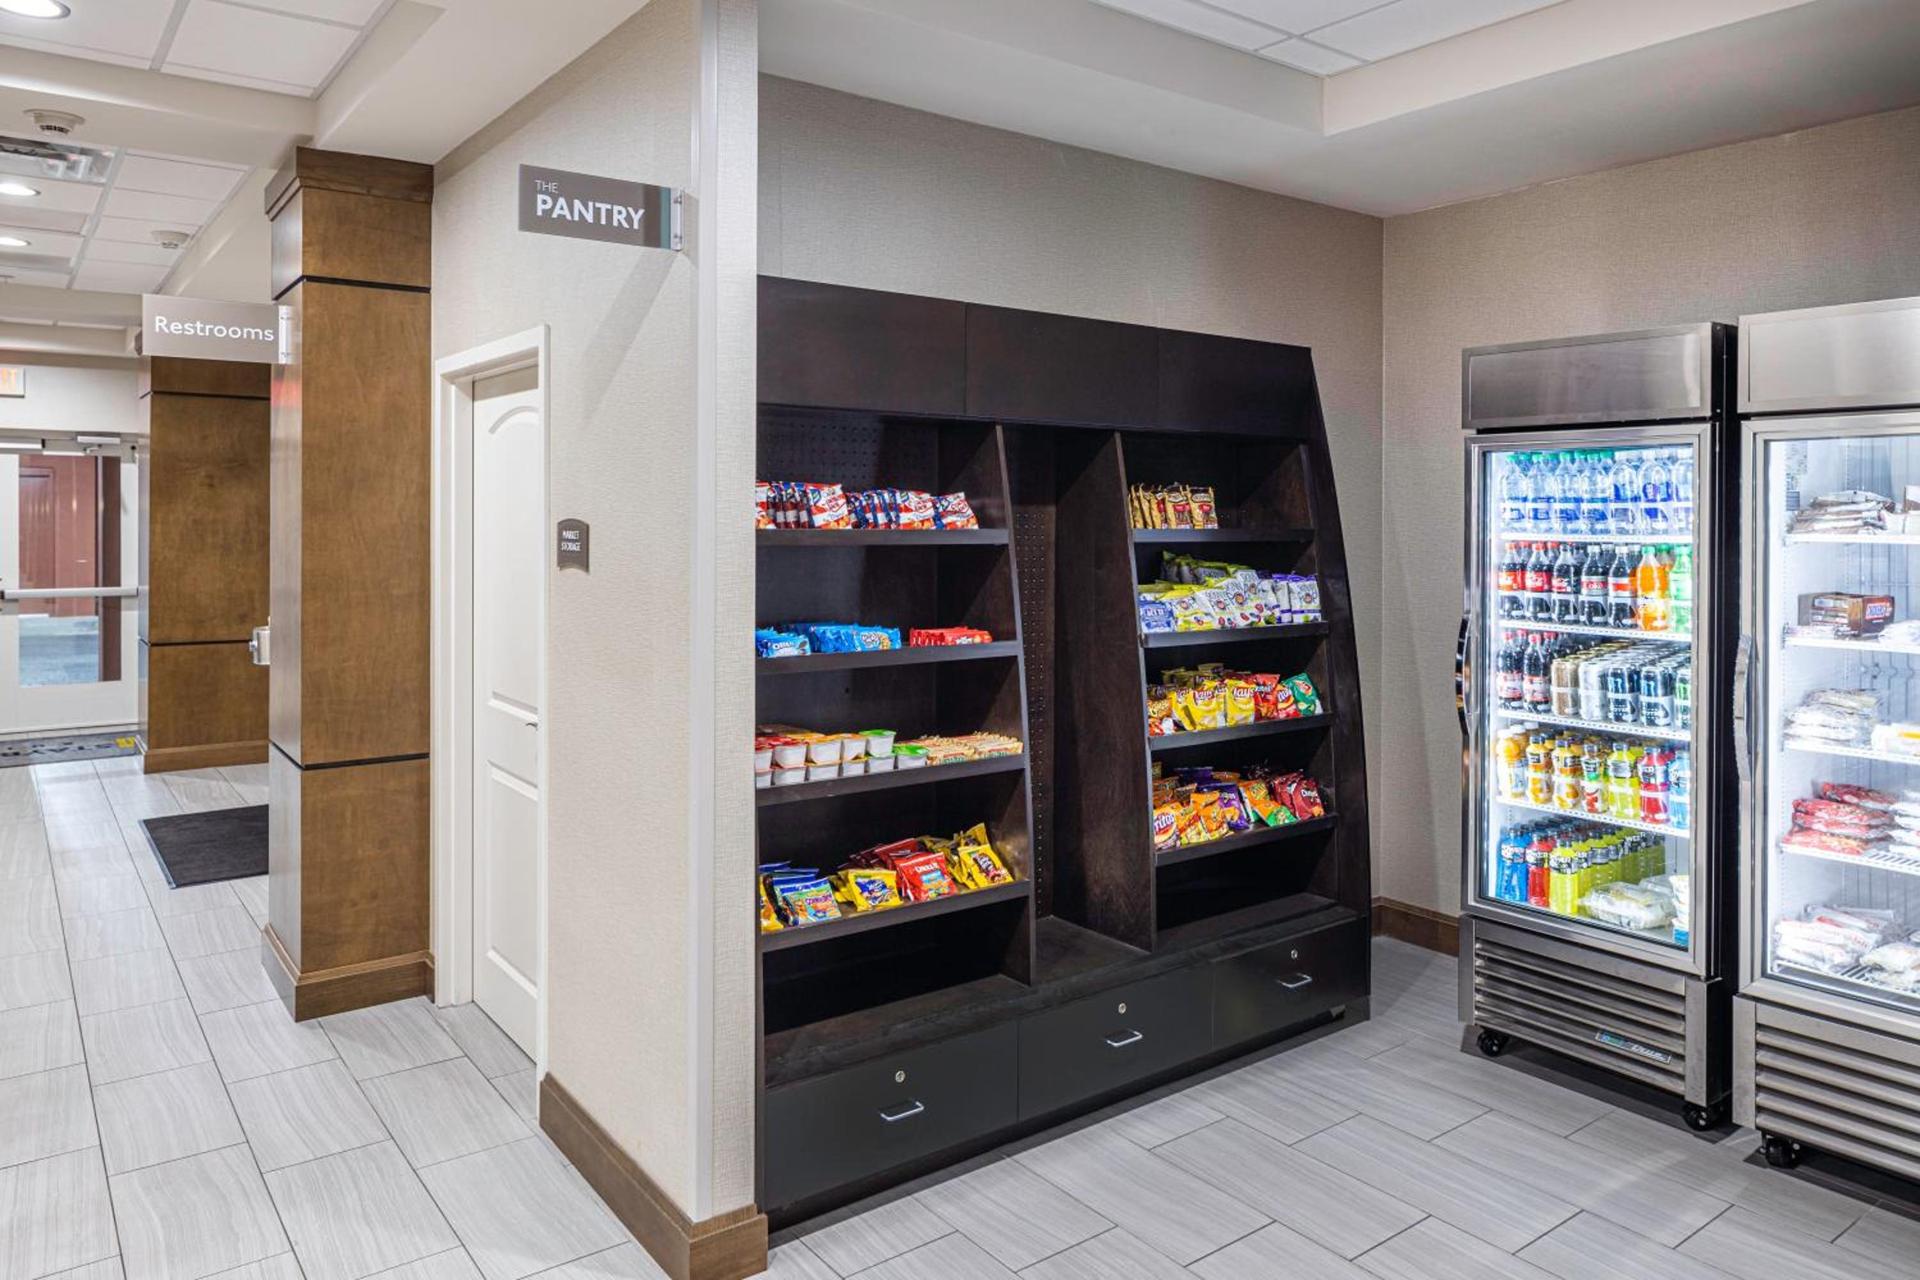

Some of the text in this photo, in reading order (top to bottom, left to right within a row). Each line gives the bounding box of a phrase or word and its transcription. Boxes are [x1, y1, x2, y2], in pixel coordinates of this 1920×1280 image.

[534, 179, 559, 194] THE
[536, 194, 646, 230] PANTRY
[154, 315, 275, 342] Restrooms
[561, 542, 582, 552] STORAGE
